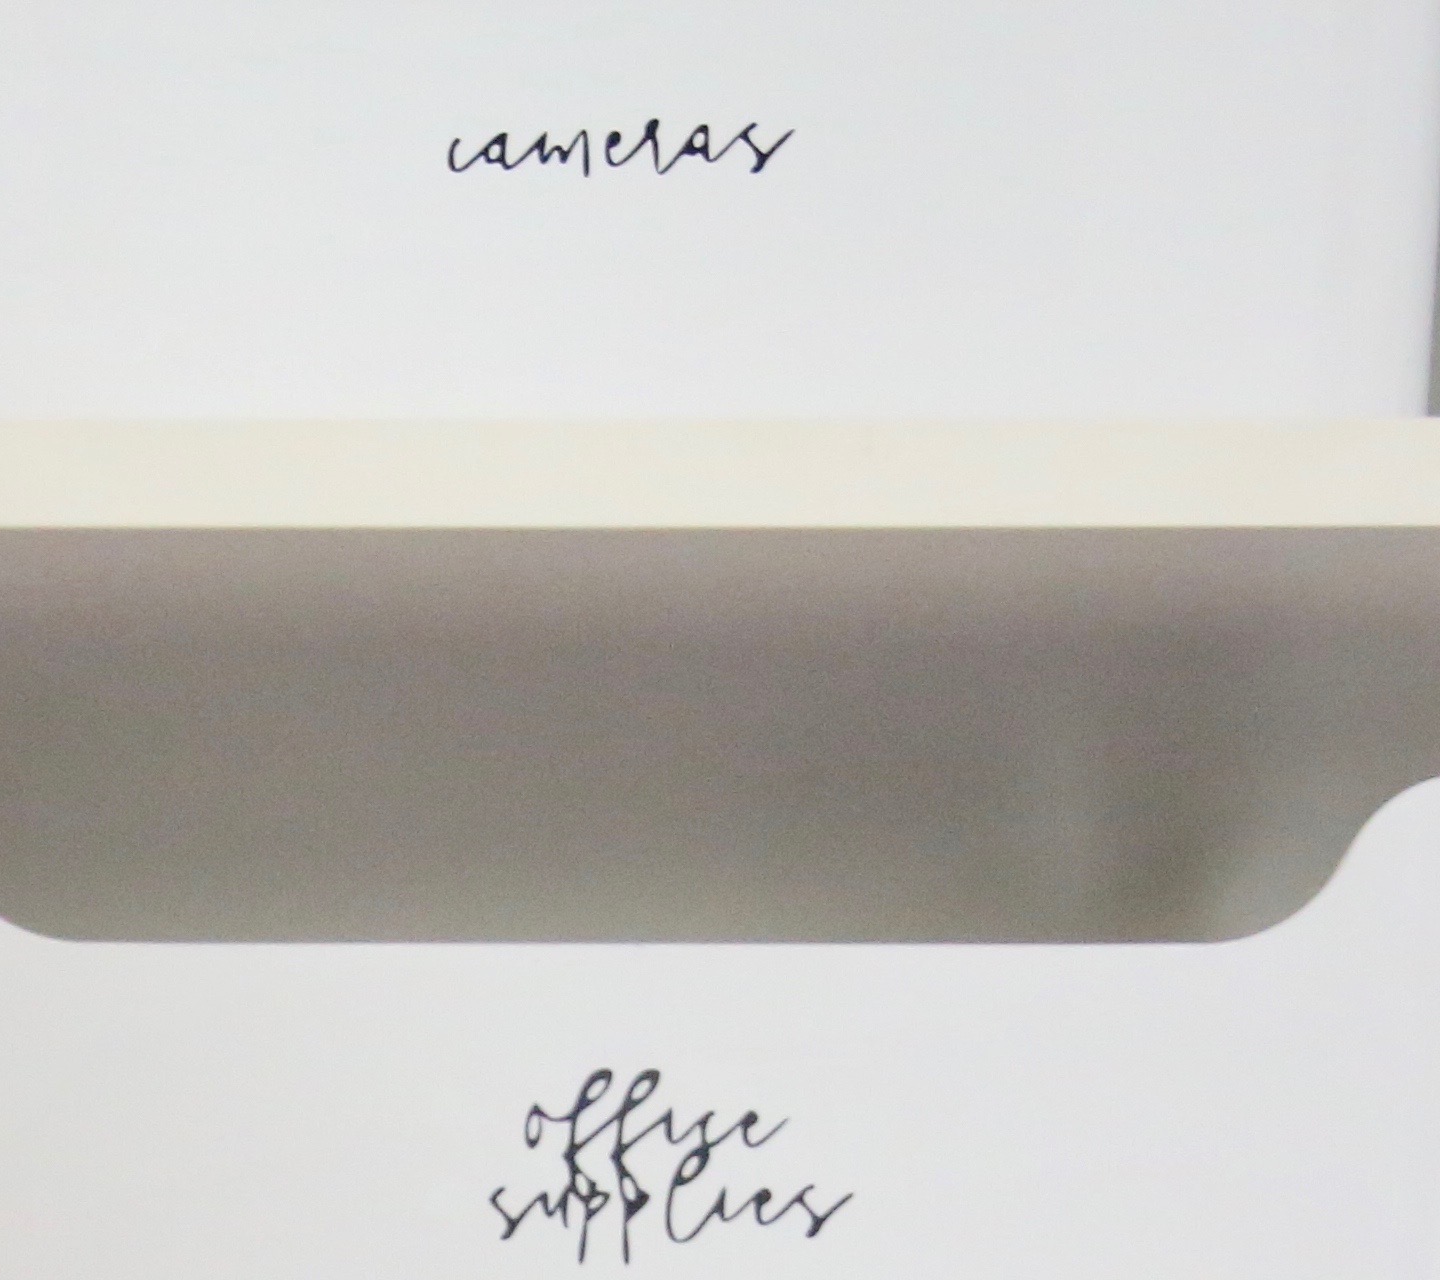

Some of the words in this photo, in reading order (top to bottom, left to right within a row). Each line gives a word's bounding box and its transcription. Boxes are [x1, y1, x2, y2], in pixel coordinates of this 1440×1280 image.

[447, 117, 796, 178] cameras
[524, 1067, 789, 1199] office
[488, 1146, 855, 1265] supplies
